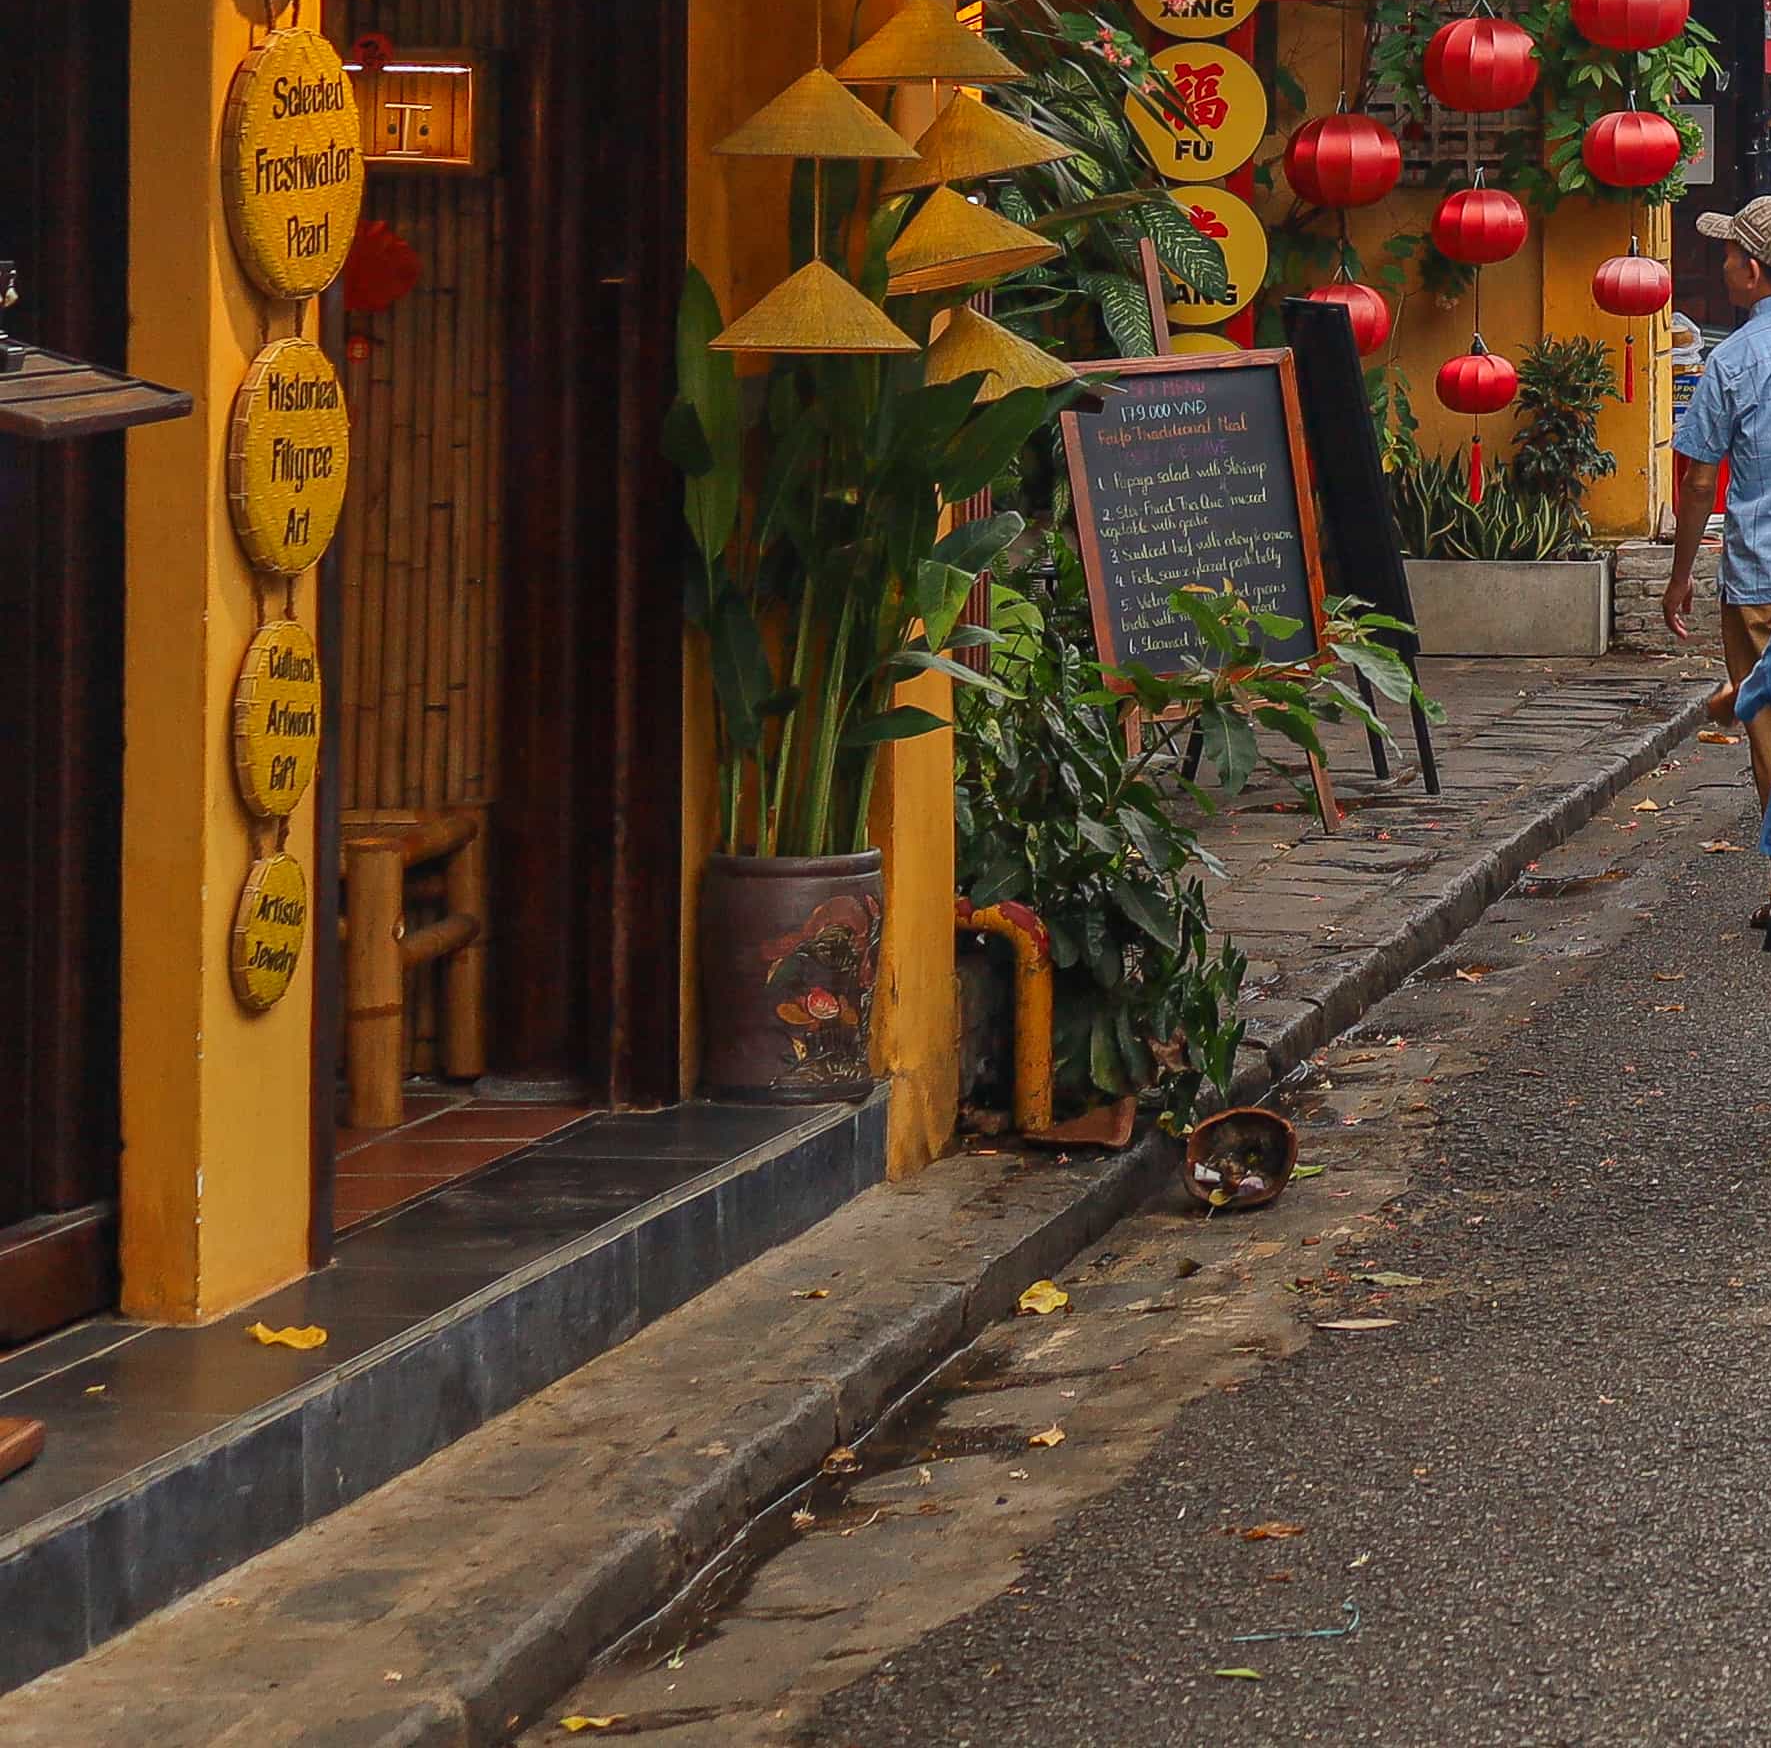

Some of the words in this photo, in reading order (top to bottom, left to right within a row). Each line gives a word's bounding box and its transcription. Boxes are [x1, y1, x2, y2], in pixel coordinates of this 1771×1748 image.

[272, 73, 345, 120] Selected
[254, 138, 356, 196] Freshwater
[1174, 139, 1214, 161] FU
[286, 212, 330, 259] Pearl
[267, 371, 341, 413] Historical
[270, 436, 333, 493] Filigree
[1113, 471, 1155, 497] Papaya
[1156, 462, 1191, 484] salad
[282, 507, 311, 546] Art
[268, 644, 316, 684] Cultural
[265, 700, 316, 738] Artwork
[270, 753, 297, 792] Gift
[255, 893, 304, 930] Artistic
[248, 939, 299, 983] Jewelry
